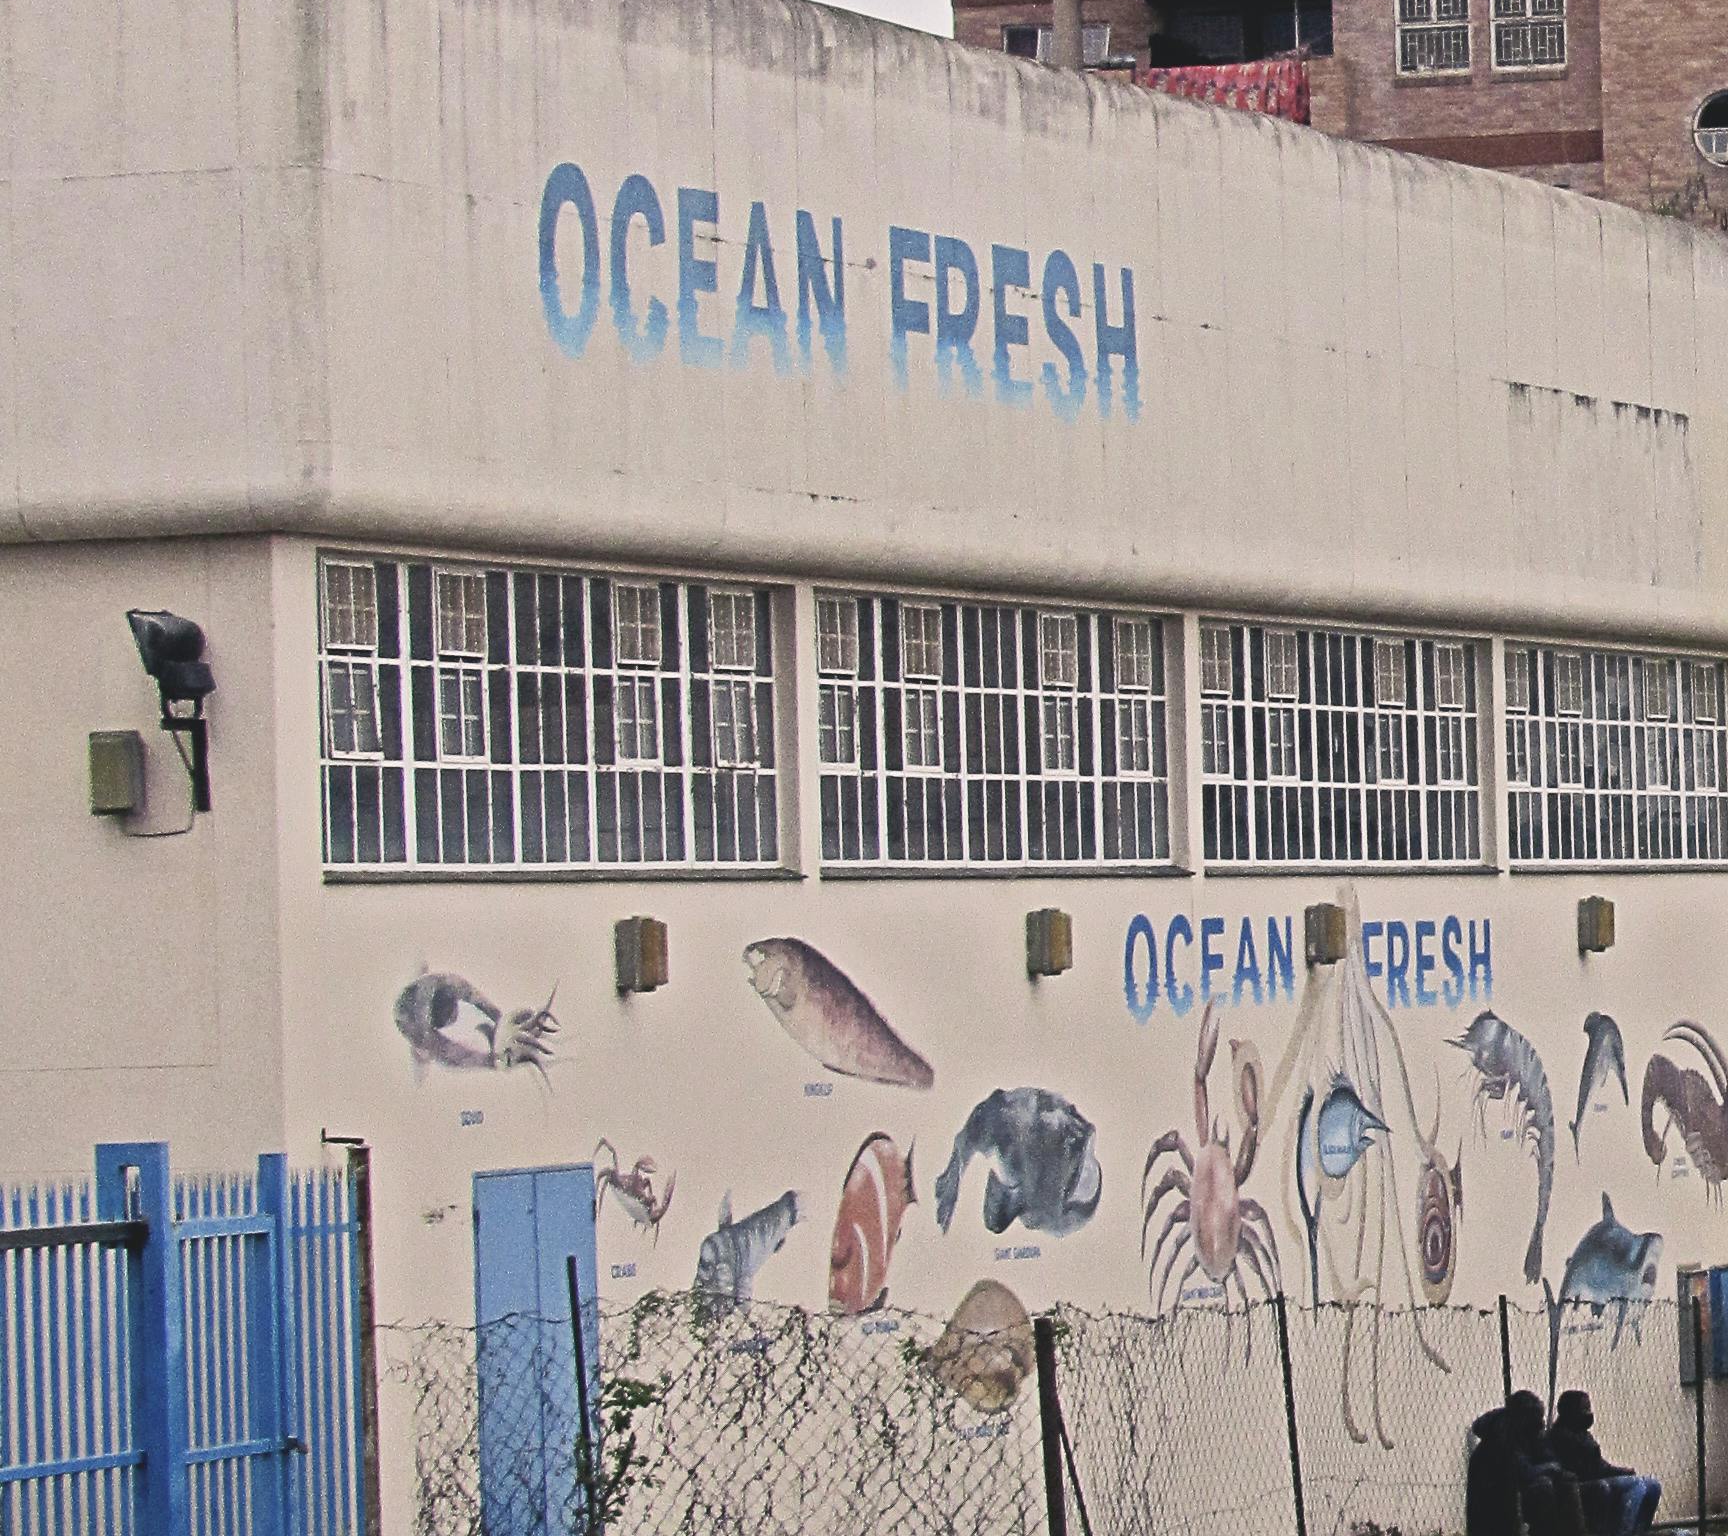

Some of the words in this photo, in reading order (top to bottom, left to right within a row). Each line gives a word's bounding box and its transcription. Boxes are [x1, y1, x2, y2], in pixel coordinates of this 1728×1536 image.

[538, 161, 847, 386] OCEAN
[888, 225, 1143, 426] FRESH
[1124, 914, 1295, 1024] OCEAN
[1362, 916, 1492, 1010] FRESH
